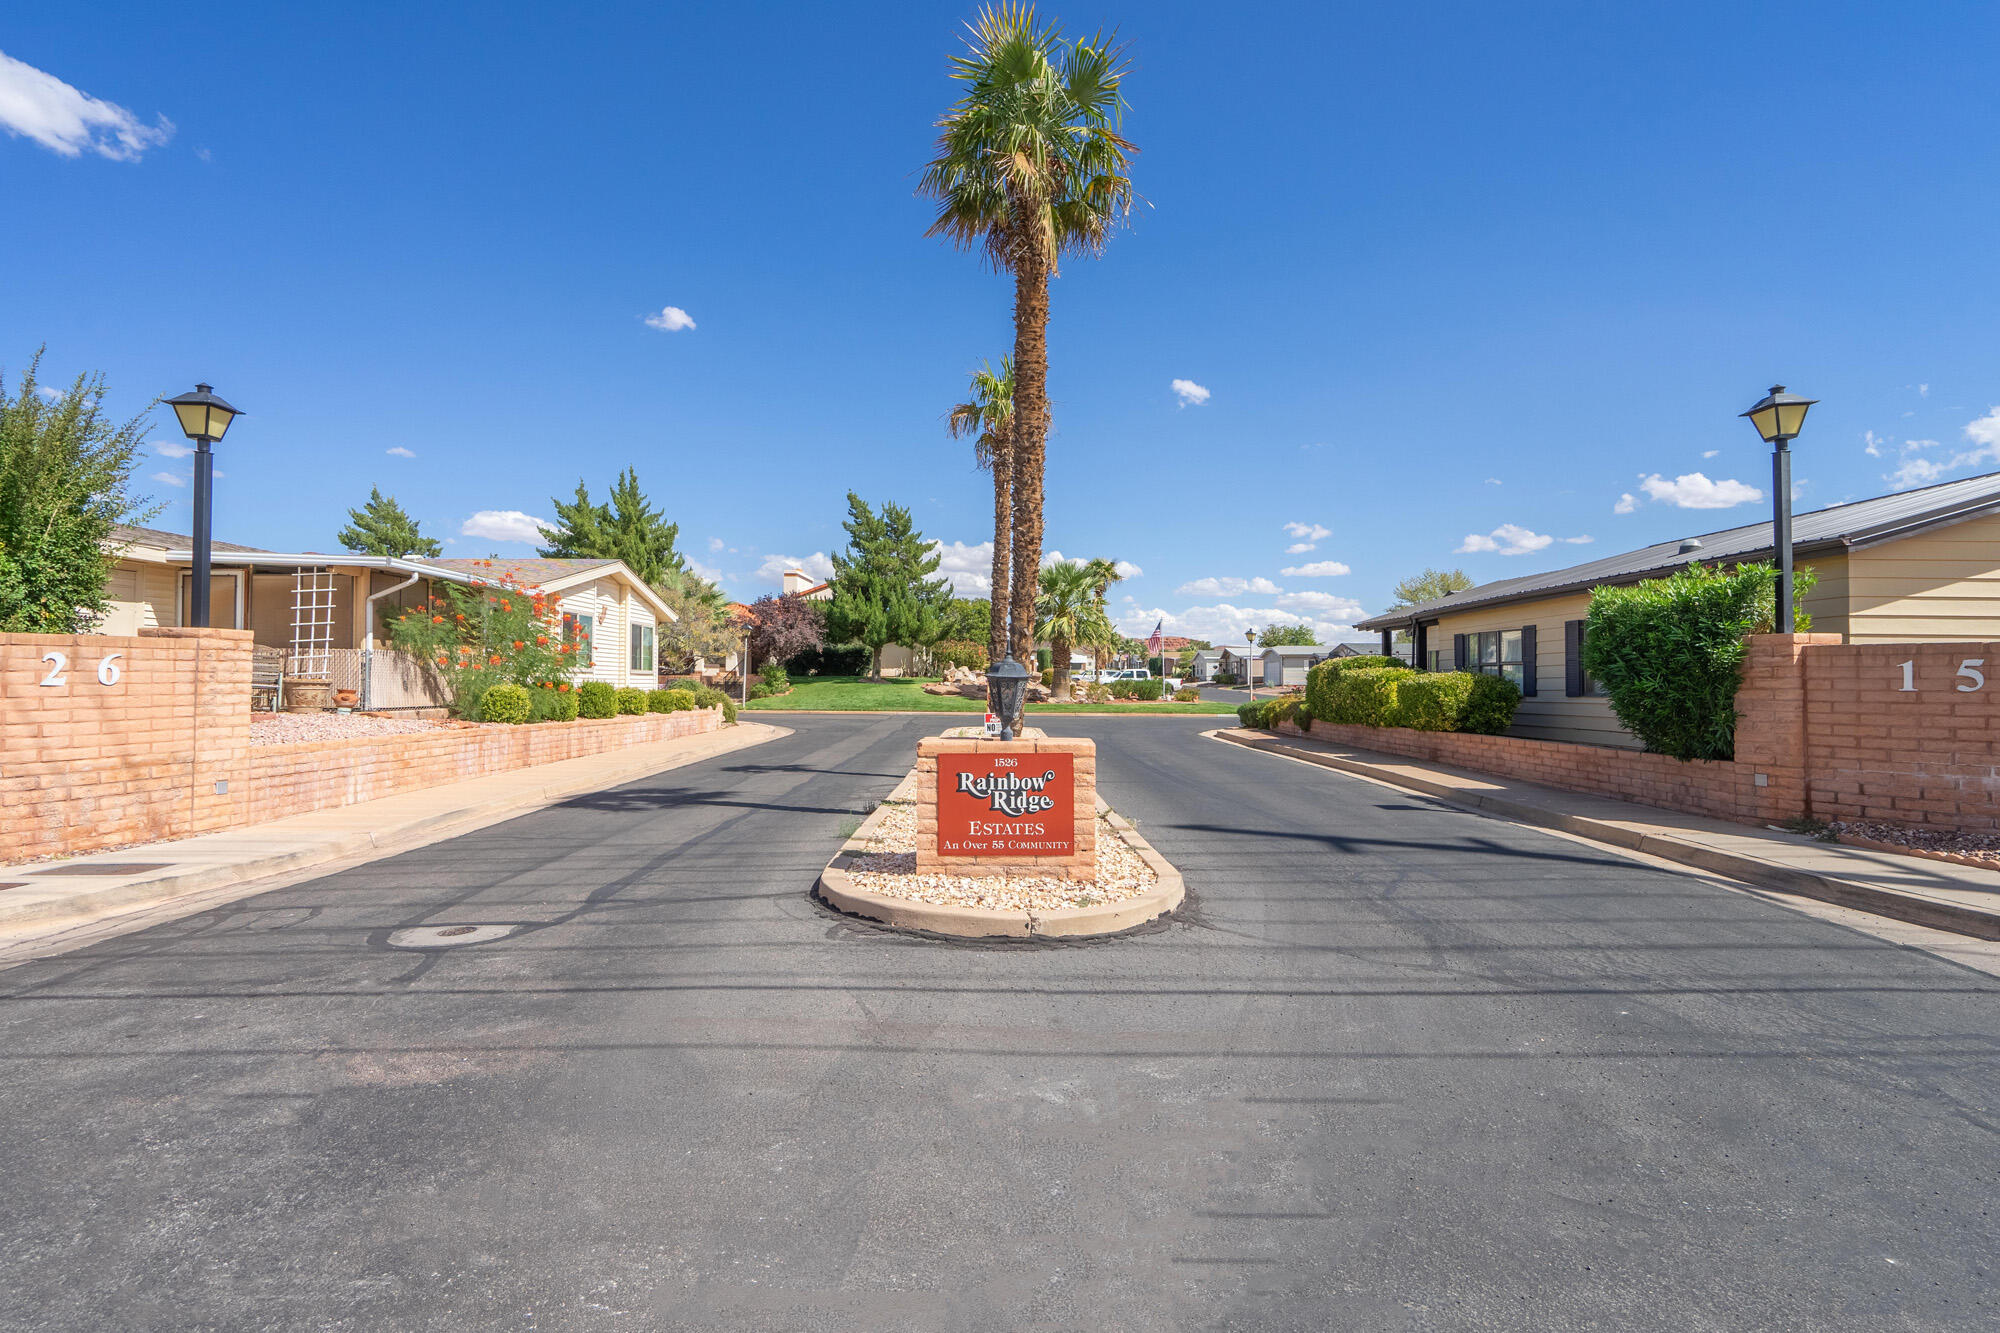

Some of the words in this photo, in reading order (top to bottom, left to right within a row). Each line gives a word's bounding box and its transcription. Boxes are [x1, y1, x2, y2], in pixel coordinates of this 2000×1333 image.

[986, 723, 996, 732] NO
[994, 758, 1018, 767] 1526
[957, 770, 1056, 798] Rainbow
[990, 790, 1054, 816] Ridge
[968, 820, 1045, 836] ESTATES
[944, 840, 959, 850] An
[963, 840, 988, 850] Over
[992, 840, 1004, 850] 55
[1008, 840, 1070, 850] COMMUNITY
